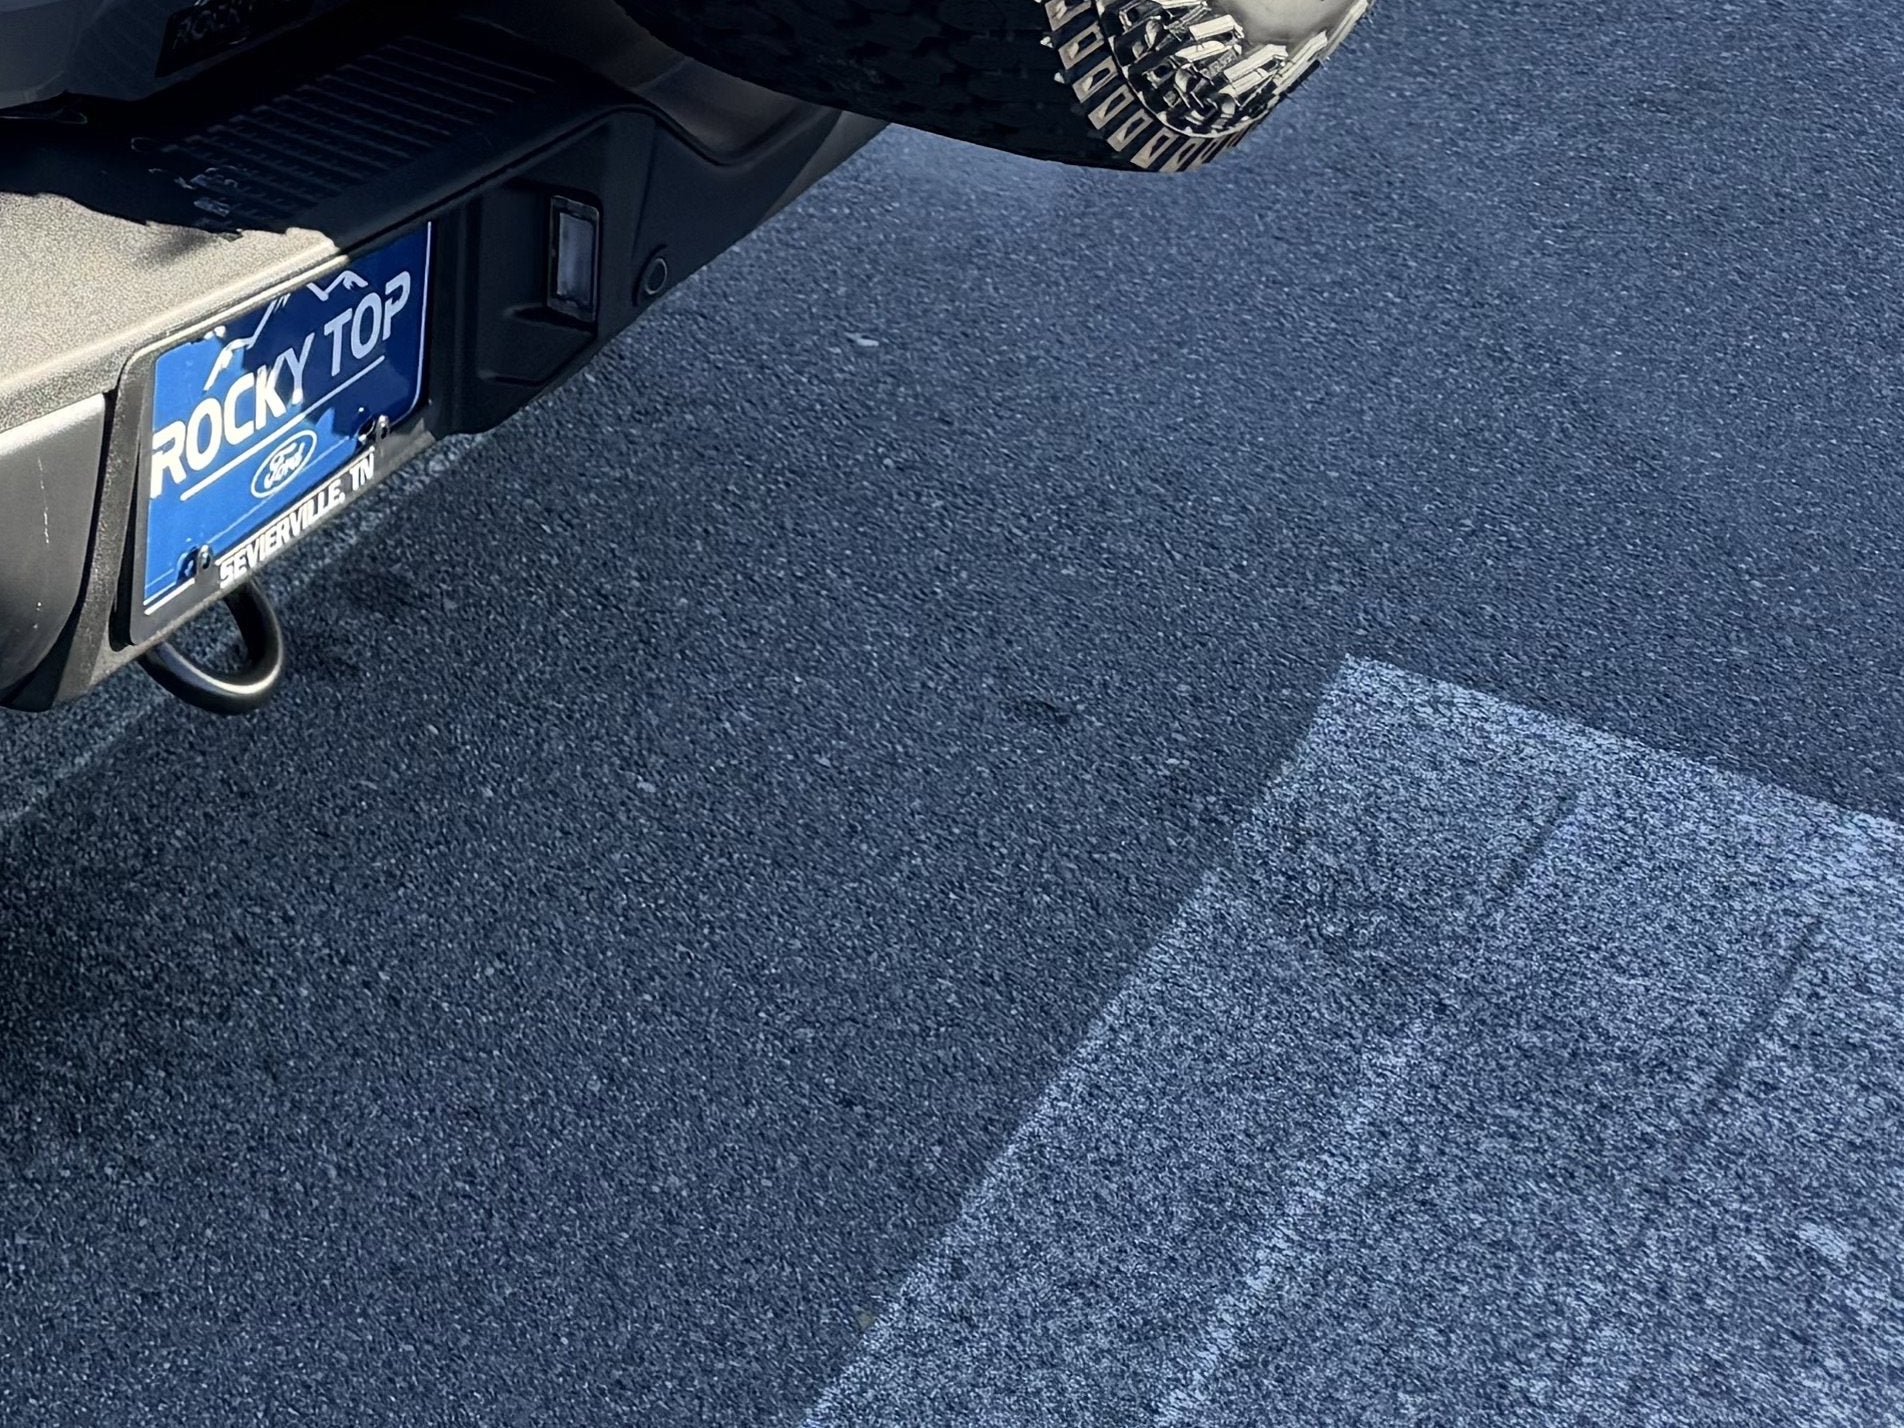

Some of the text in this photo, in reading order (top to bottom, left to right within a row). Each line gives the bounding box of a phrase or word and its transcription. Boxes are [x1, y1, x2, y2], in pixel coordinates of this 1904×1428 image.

[149, 270, 412, 499] ROCKY TOP
[219, 452, 375, 589] SEVIERVILLE, TN
[263, 441, 306, 490] Ford
